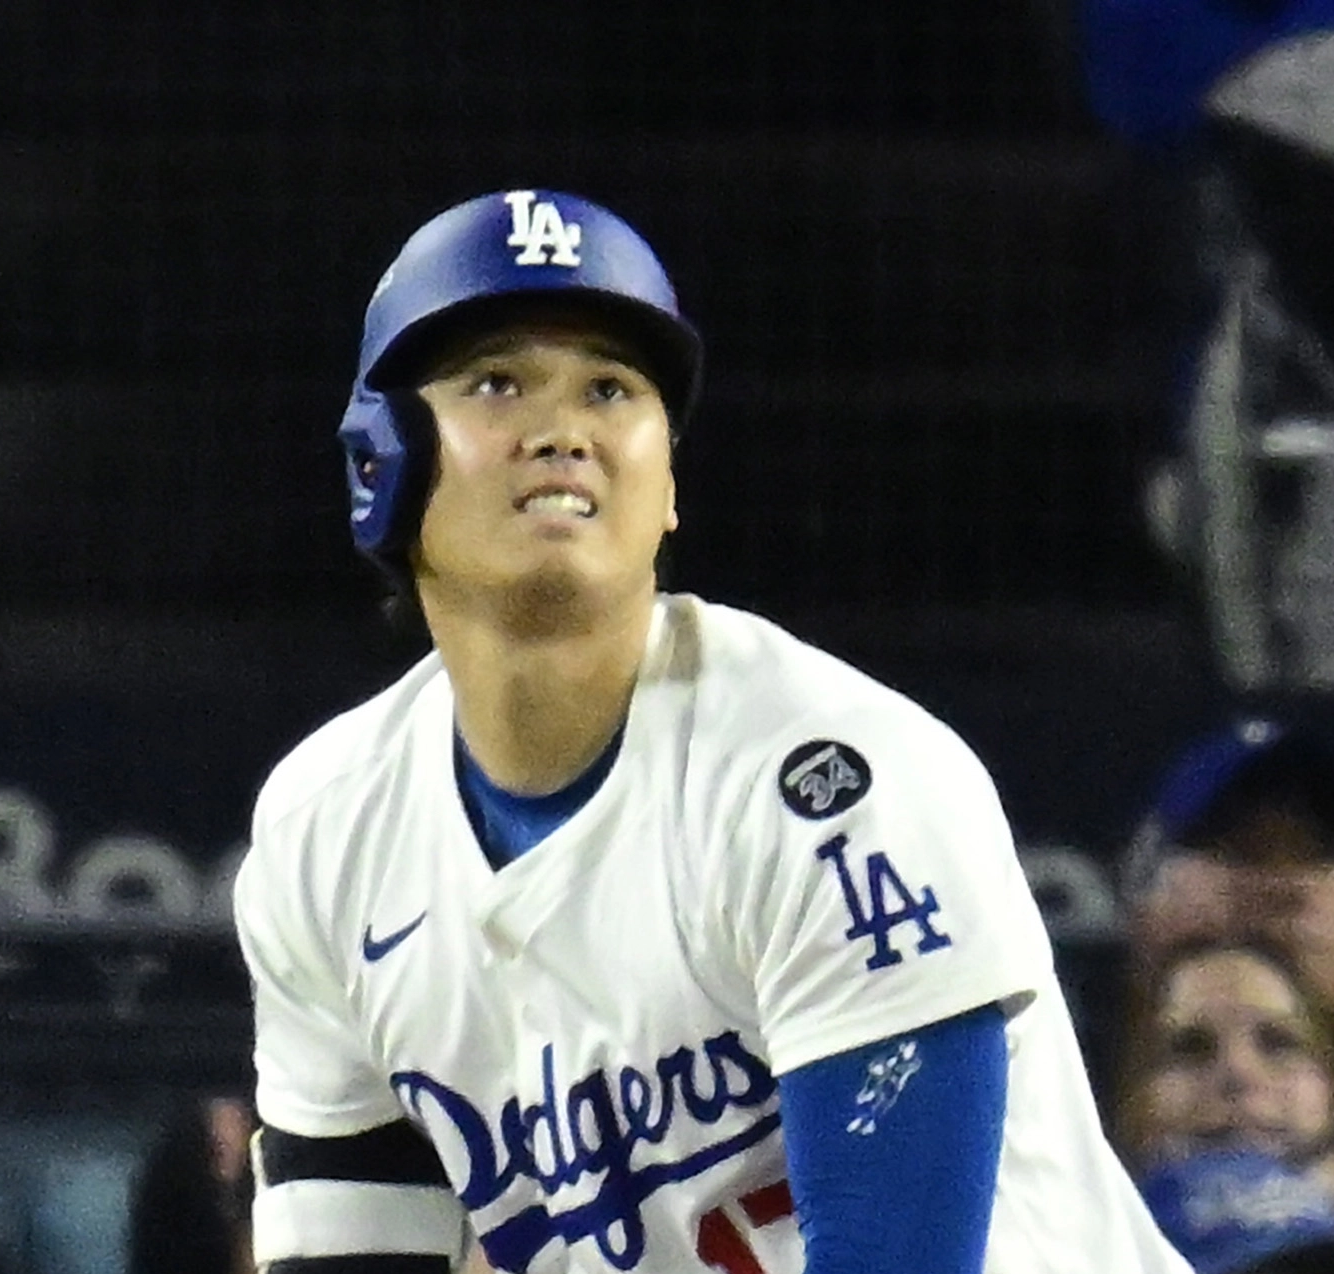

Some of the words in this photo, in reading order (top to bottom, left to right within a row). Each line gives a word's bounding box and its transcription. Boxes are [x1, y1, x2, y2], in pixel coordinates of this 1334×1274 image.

[504, 189, 582, 267] LA
[815, 831, 953, 971] LA
[390, 1029, 779, 1273] Dodgers
